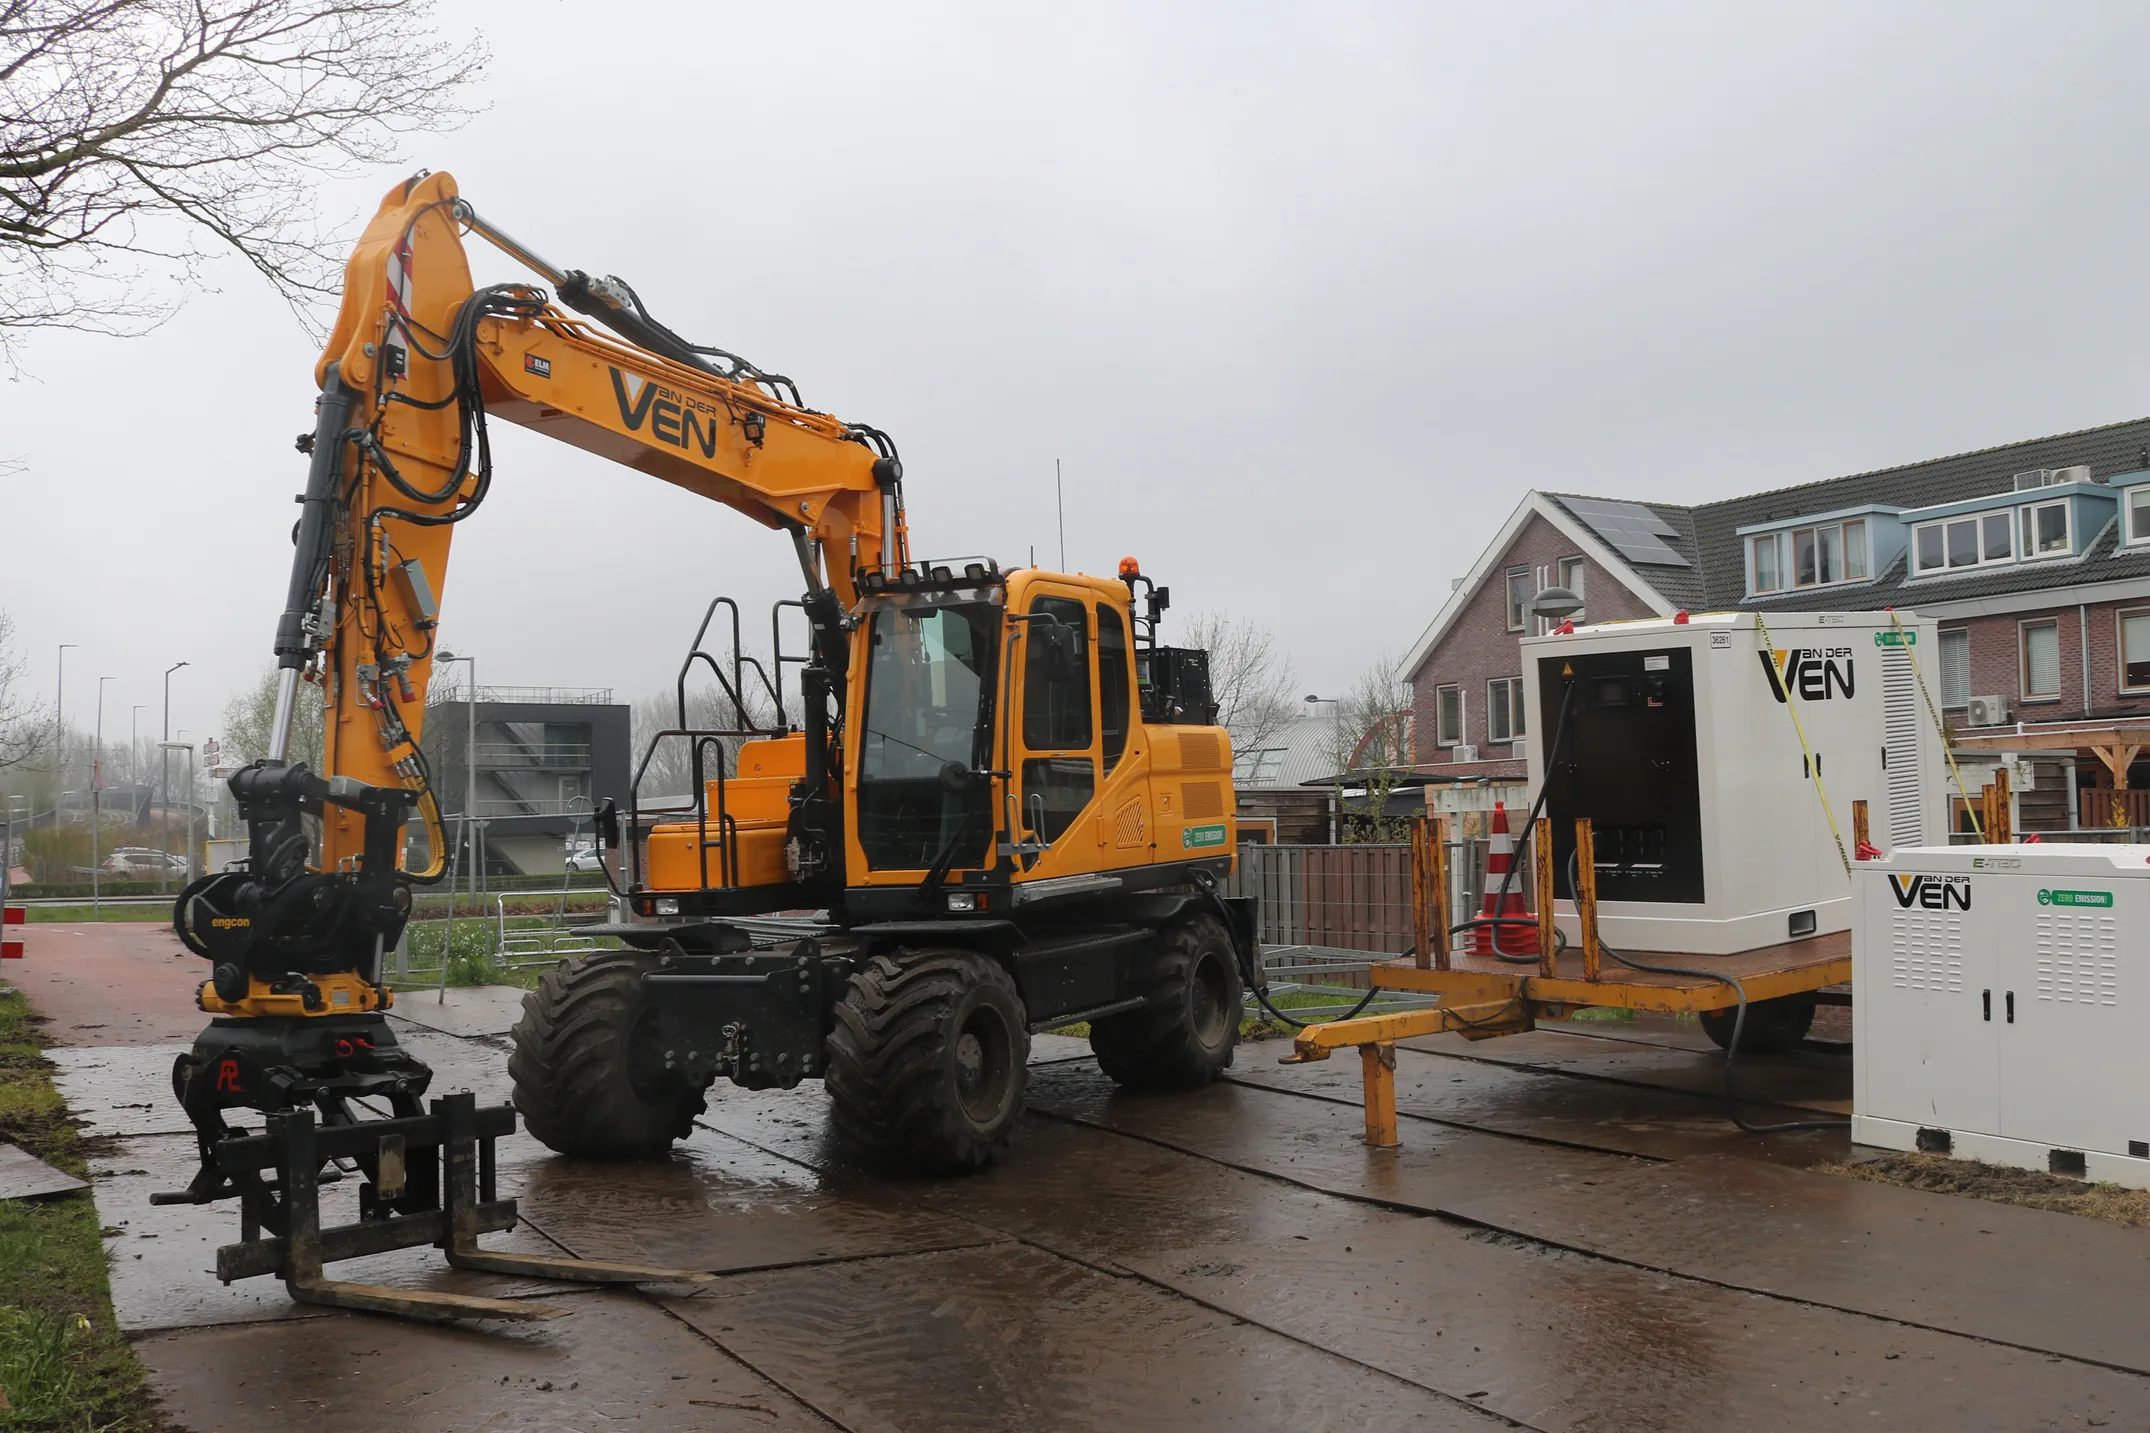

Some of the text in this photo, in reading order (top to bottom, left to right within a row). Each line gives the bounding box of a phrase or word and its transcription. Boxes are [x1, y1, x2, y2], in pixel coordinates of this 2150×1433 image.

[608, 365, 717, 459] VEN
[685, 397, 716, 417] DER
[1711, 635, 1729, 645] 36261
[1826, 648, 1853, 658] DER
[1758, 649, 1855, 703] VEN
[1972, 857, 2022, 869] E-TEC
[1887, 874, 1971, 911] VEN
[2057, 894, 2073, 902] ZERO
[211, 917, 250, 929] engcon
